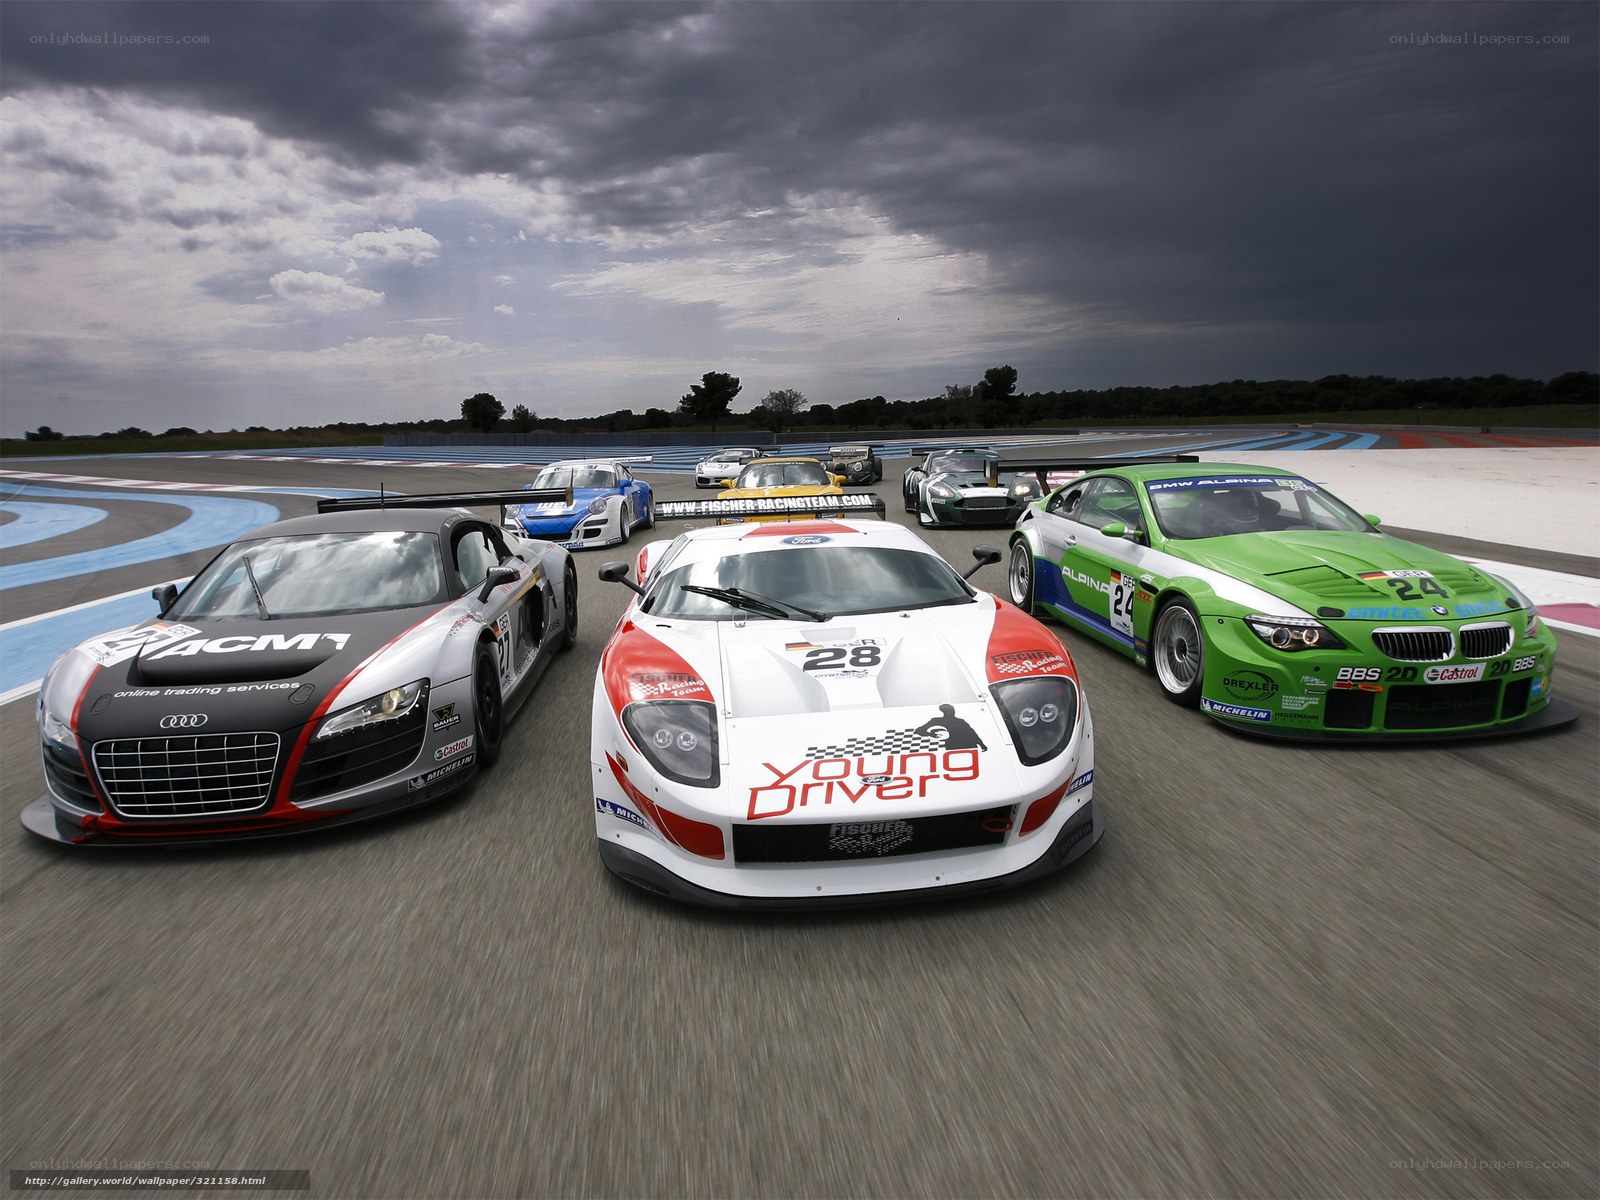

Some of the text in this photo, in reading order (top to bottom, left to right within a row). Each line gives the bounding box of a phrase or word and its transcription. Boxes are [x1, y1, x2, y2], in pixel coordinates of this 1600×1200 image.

[1150, 481, 1193, 490] BMW
[1197, 478, 1274, 486] ALPINA
[661, 494, 873, 514] WWW.FISCHER-RACINGTEAM.COM
[790, 536, 822, 544] Ford
[1062, 565, 1110, 594] ALPINA
[1392, 570, 1424, 578] GER
[1386, 578, 1449, 601] 24
[1113, 584, 1134, 622] 24
[498, 629, 511, 678] 27
[803, 646, 881, 672] 28
[991, 651, 1056, 664] FISCHER
[1022, 655, 1064, 671] Racing
[1039, 662, 1068, 673] Team
[1490, 660, 1511, 676] 2D
[1512, 655, 1536, 672] BBS
[630, 673, 697, 683] FISCHER
[1336, 667, 1381, 681] BBS
[1386, 666, 1418, 682] 2D
[1439, 666, 1478, 681] Castrol
[114, 681, 300, 699] online trading services
[657, 680, 705, 694] Racing
[670, 686, 706, 697] Team
[1223, 677, 1279, 693] DREXLER
[1212, 703, 1268, 719] MICHELIN
[1274, 712, 1319, 720] HEGGEMANN
[433, 715, 460, 728] BAUER
[443, 738, 469, 757] Castrol
[426, 754, 473, 782] MICHELIN
[866, 775, 887, 783] Ford
[747, 775, 940, 821] Driver
[830, 820, 907, 836] FISCHER
